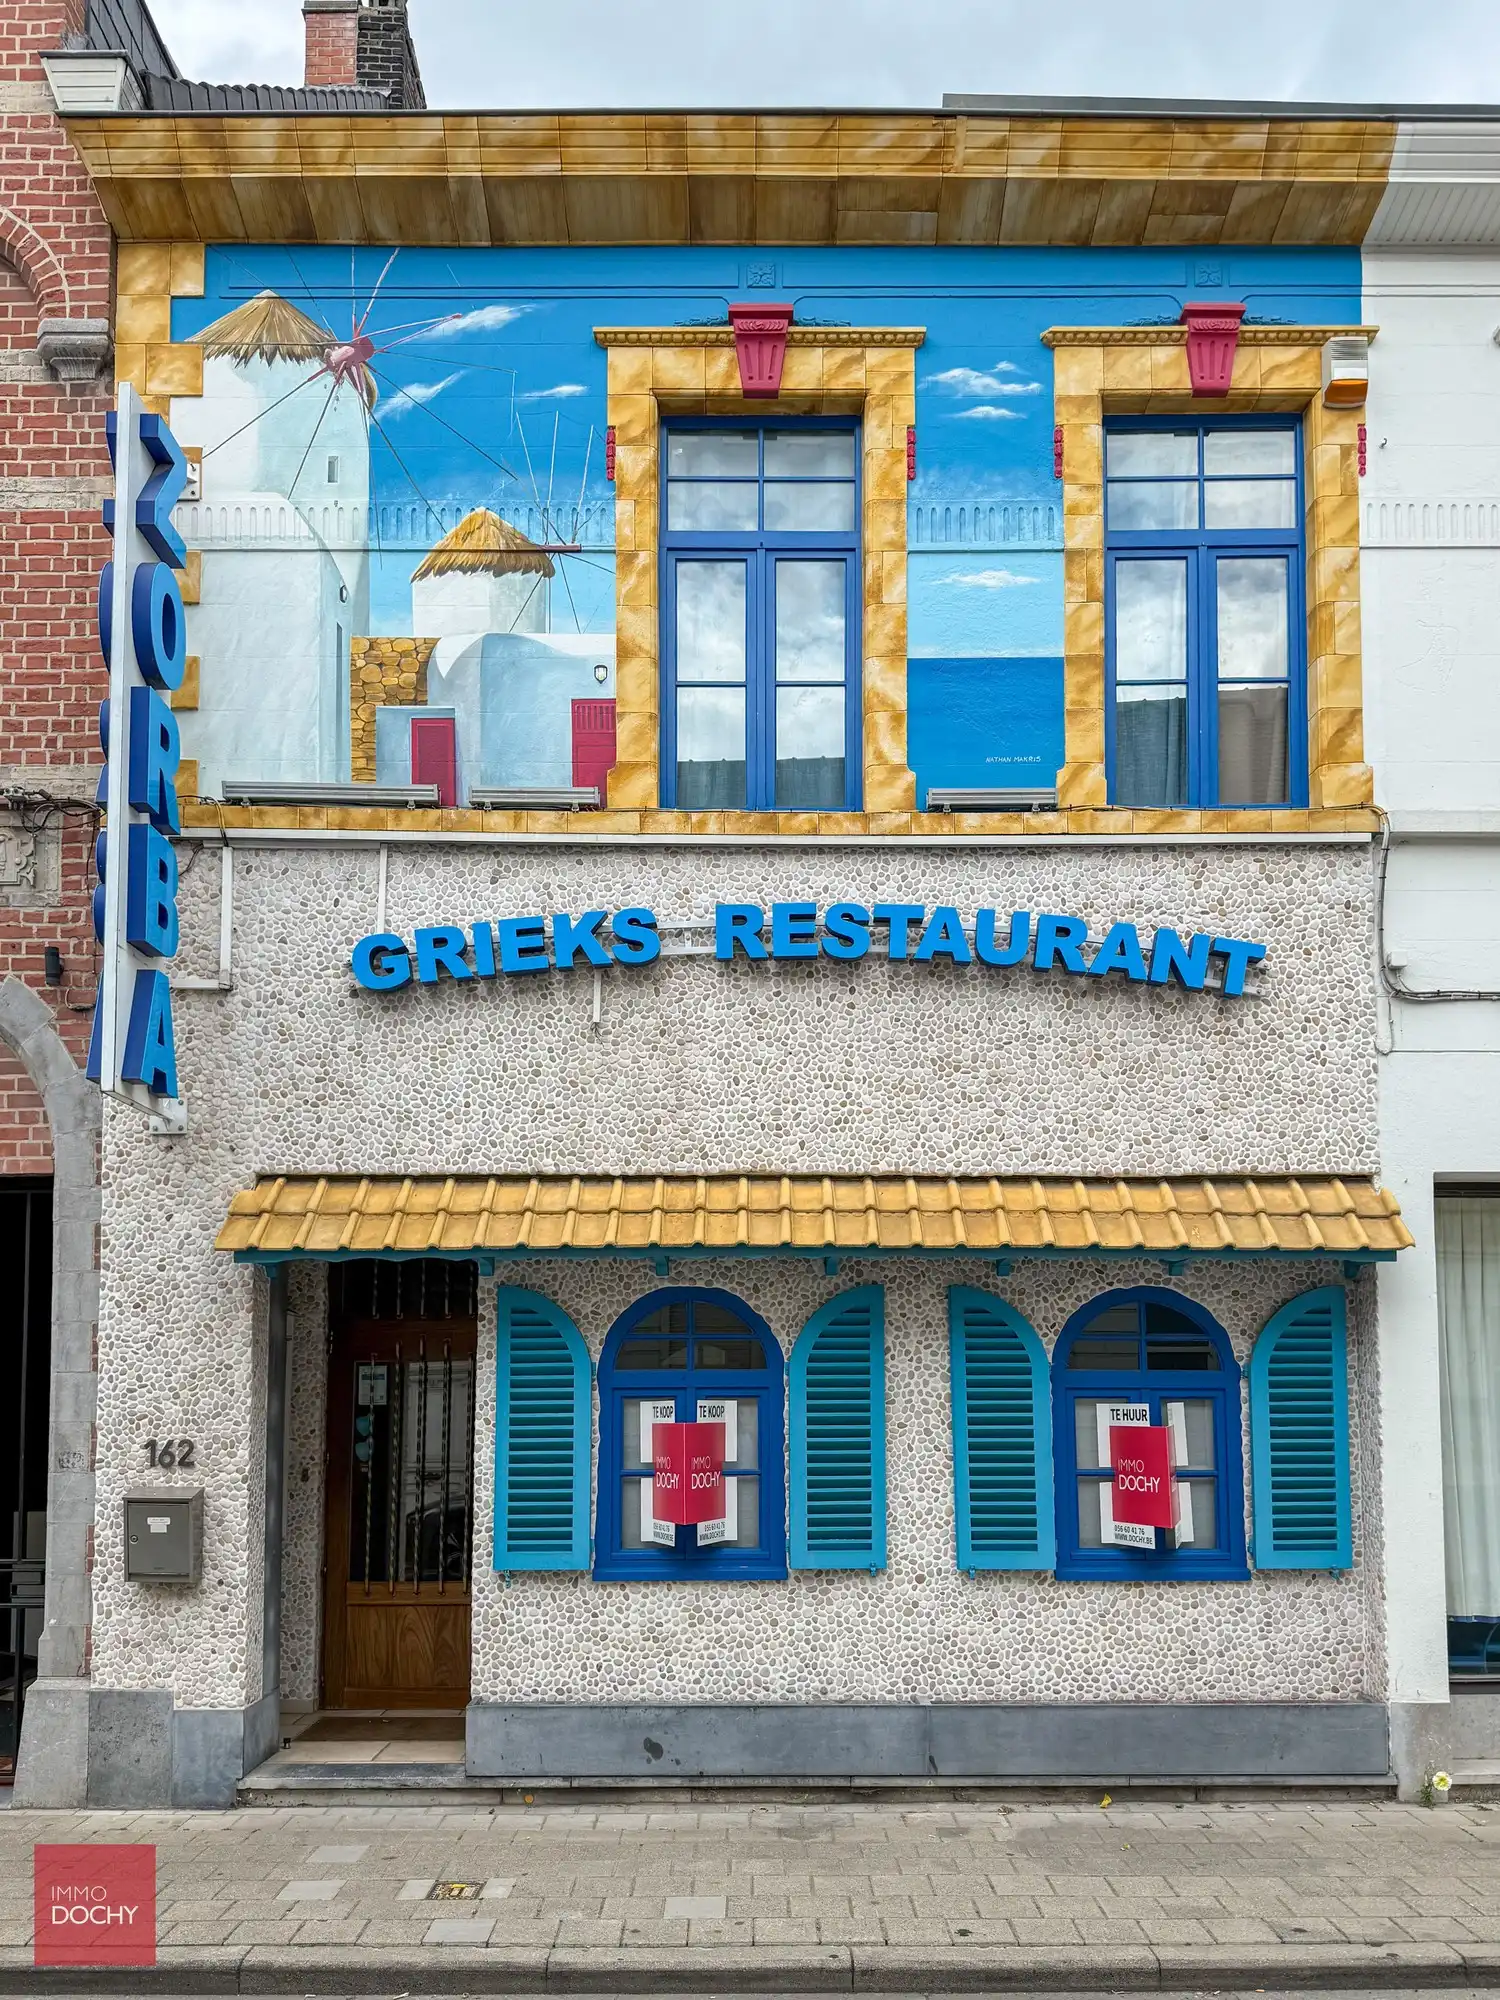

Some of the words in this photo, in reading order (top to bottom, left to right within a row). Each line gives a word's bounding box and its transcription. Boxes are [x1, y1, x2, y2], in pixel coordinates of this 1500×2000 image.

[124, 413, 188, 1098] ZORBA
[1013, 755, 1042, 763] MAKRIS
[351, 907, 662, 992] GRIEKS
[715, 902, 1267, 1000] RESTAURANT
[653, 1406, 659, 1418] TE
[660, 1405, 674, 1418] KOOP
[699, 1405, 707, 1418] TE
[708, 1405, 725, 1418] KOOP
[1110, 1408, 1121, 1421] TE
[1122, 1408, 1148, 1422] HUUR
[144, 1439, 195, 1468] 162
[655, 1456, 672, 1470] IMMO
[691, 1455, 711, 1471] IMMO
[1117, 1459, 1145, 1473] IMMO
[656, 1471, 680, 1489] DOCHY
[691, 1470, 721, 1490] DOCHY
[1118, 1474, 1161, 1493] DOCHY
[1114, 1524, 1124, 1533] 056
[1124, 1525, 1131, 1534] 60
[1131, 1526, 1138, 1535] 41
[1138, 1527, 1146, 1536] 76
[1114, 1532, 1154, 1545] WWW.DOCHY.BE
